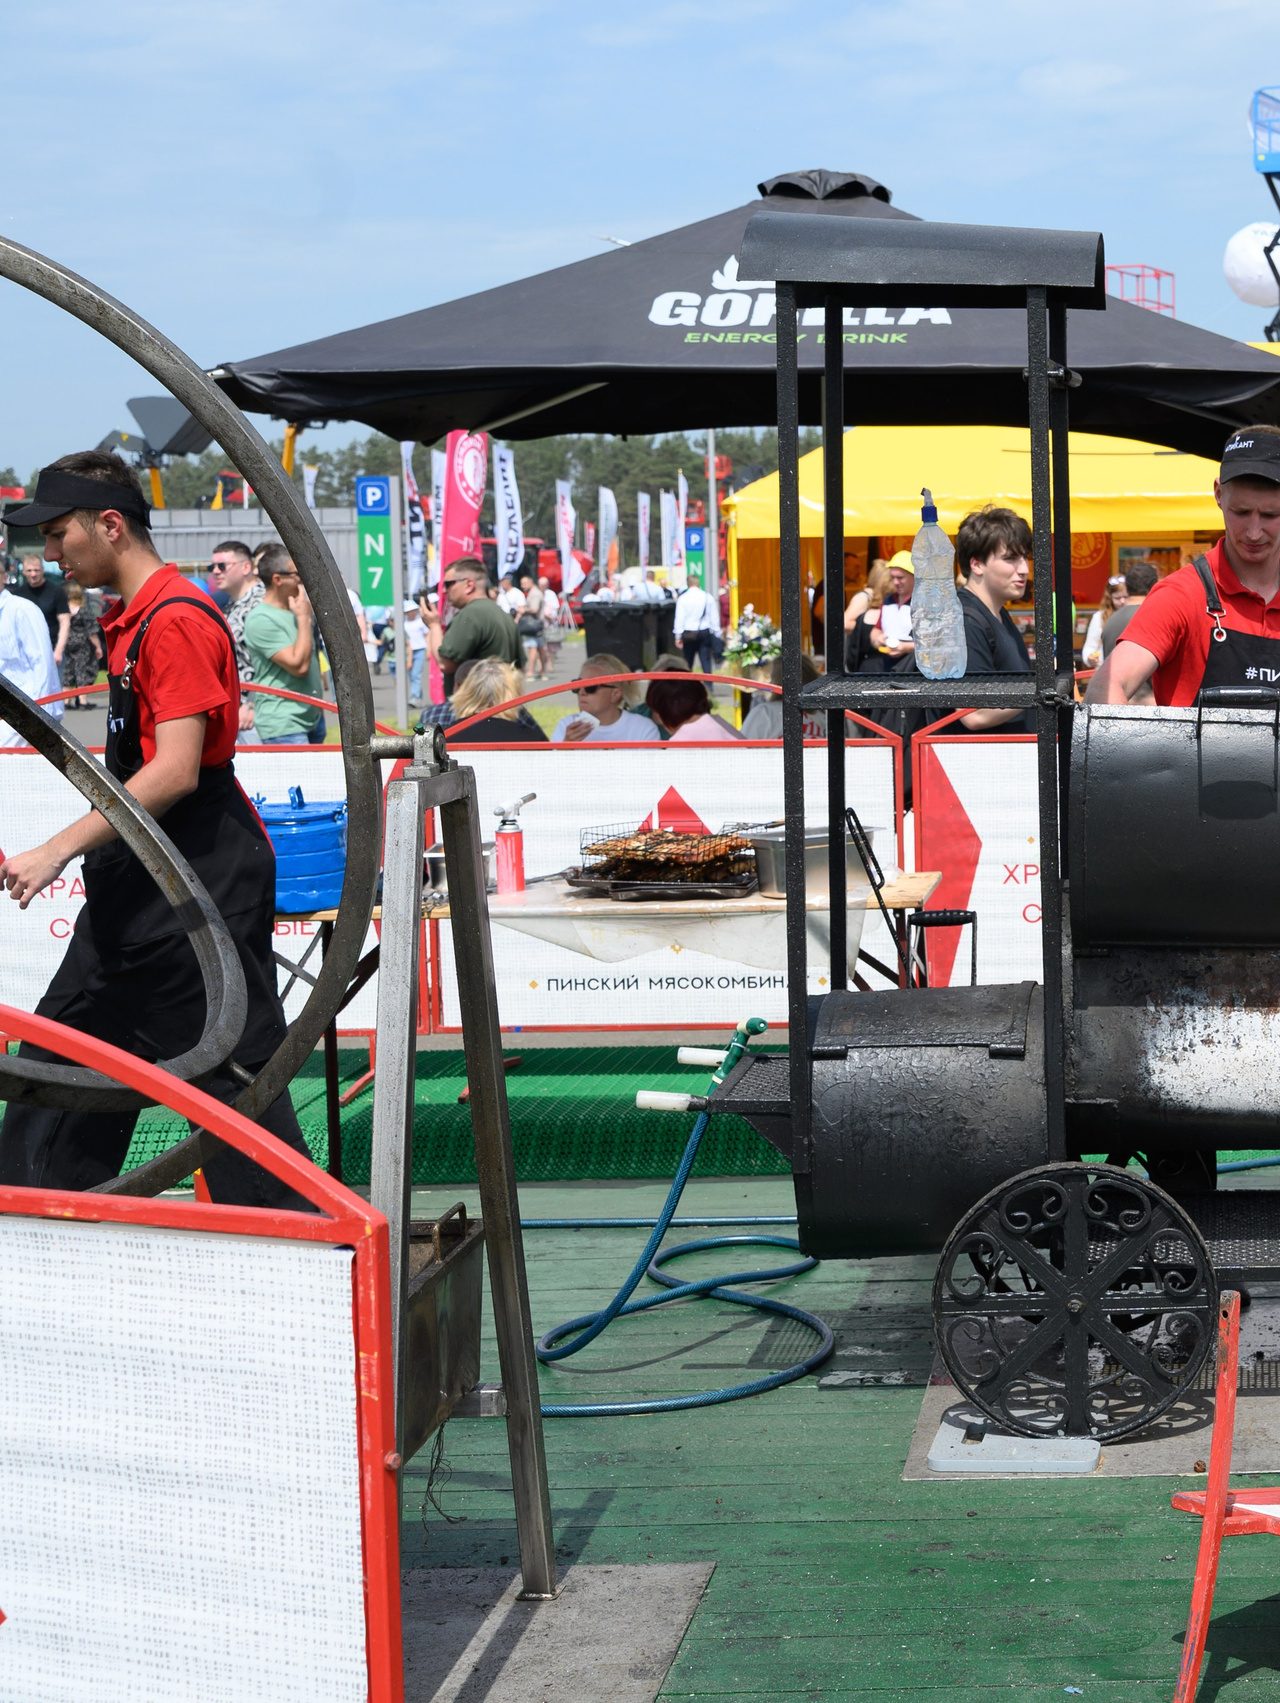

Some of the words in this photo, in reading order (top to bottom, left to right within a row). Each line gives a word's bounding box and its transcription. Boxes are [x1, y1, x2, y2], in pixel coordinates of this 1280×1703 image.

[648, 291, 952, 328] GOLLA
[366, 487, 382, 507] P
[364, 533, 385, 556] N
[690, 533, 701, 547] P
[367, 567, 384, 589] 7
[547, 975, 639, 991] ПИНСКИЙ
[649, 975, 789, 989] МЯСОКОМБИН
